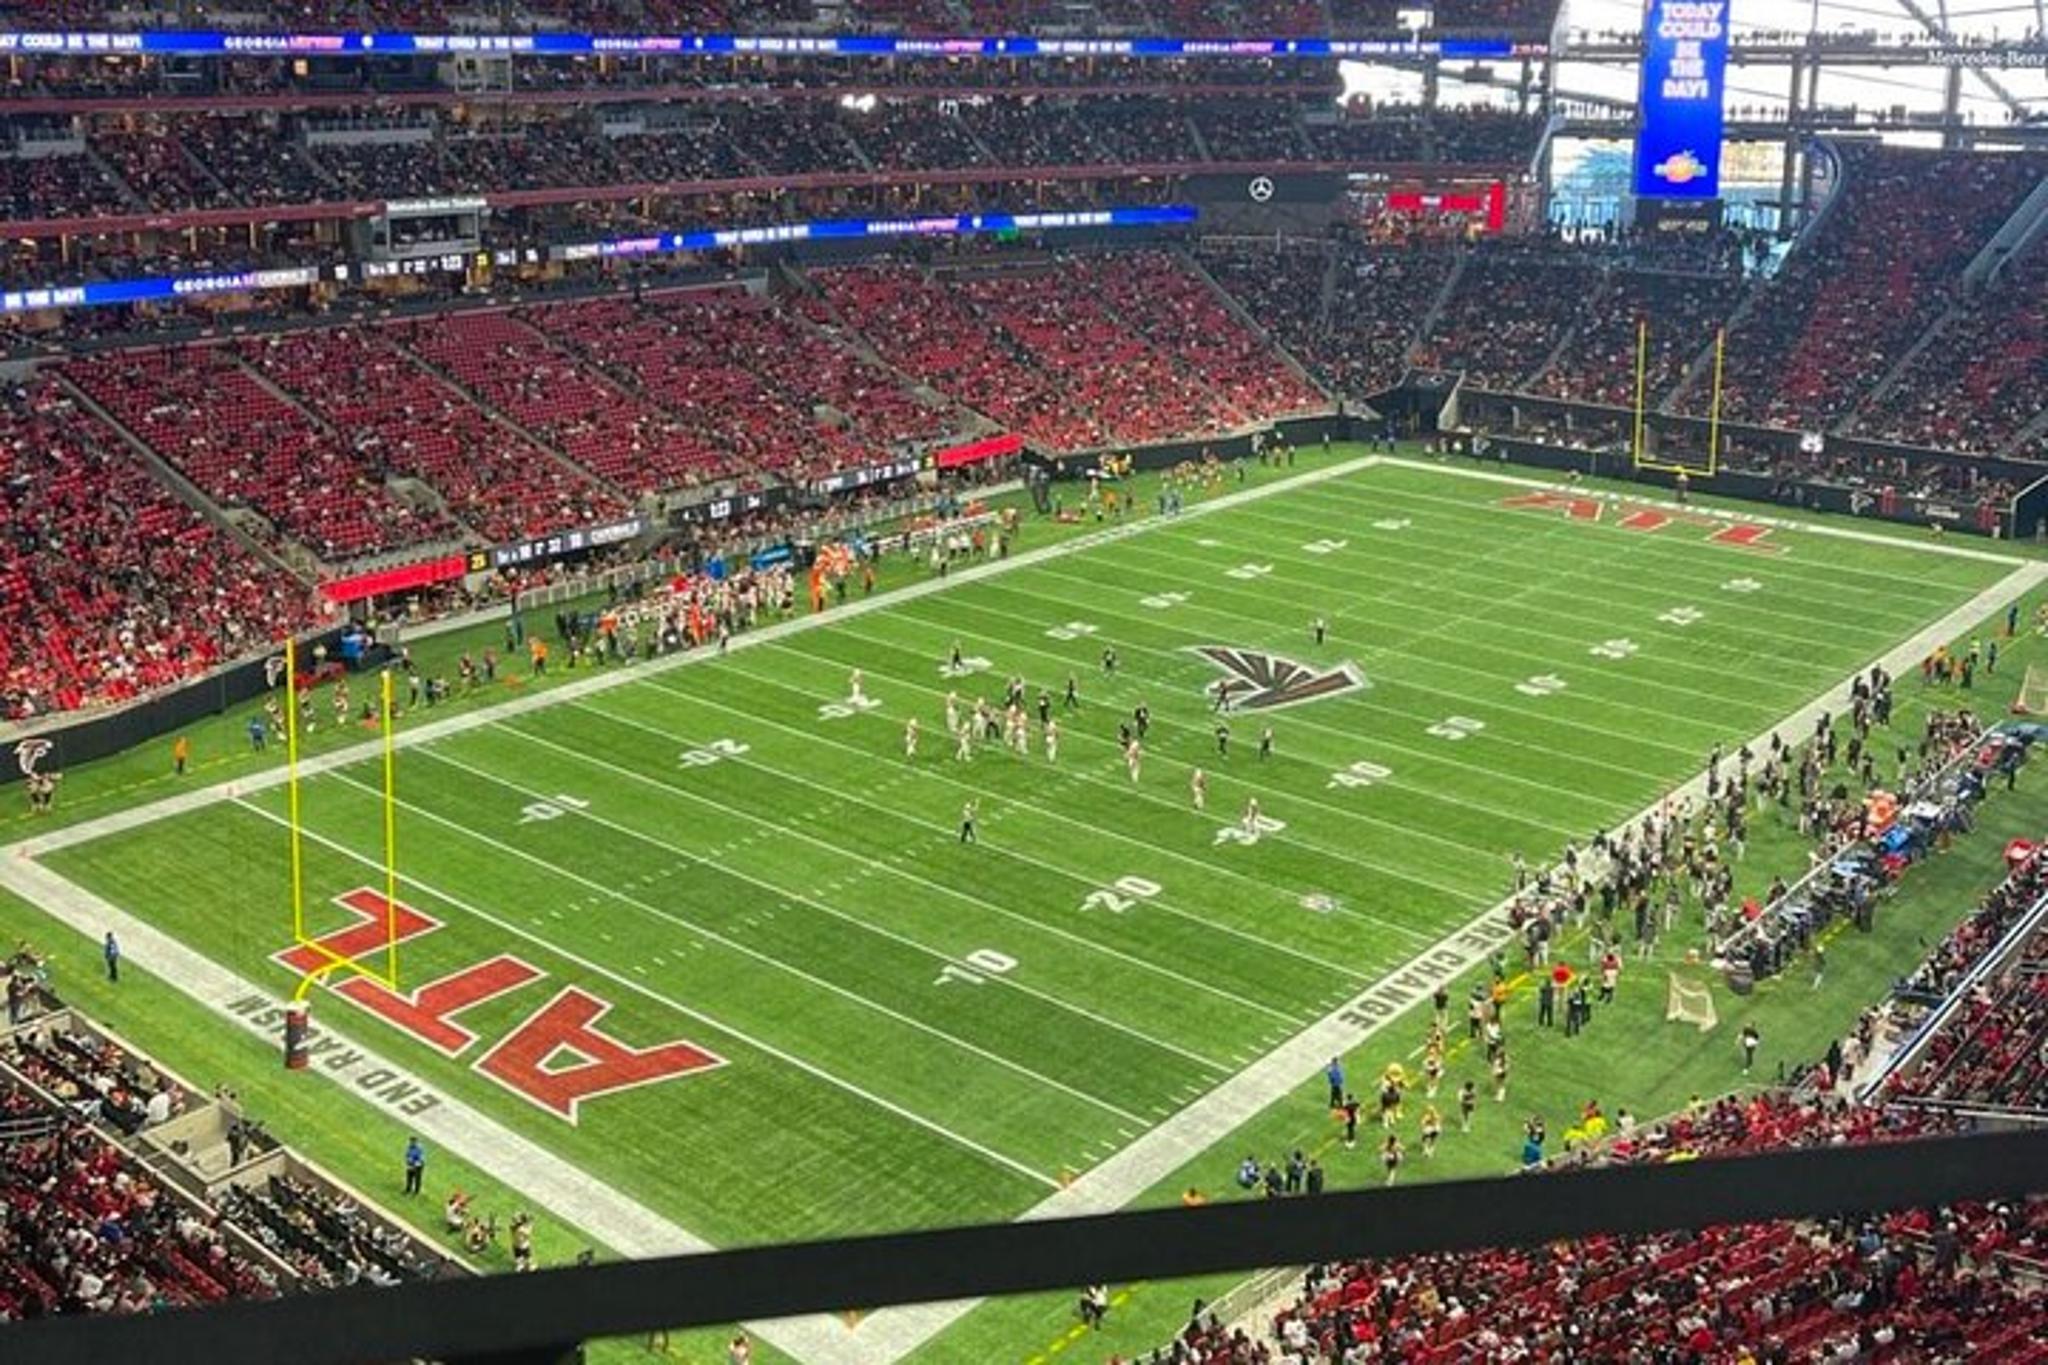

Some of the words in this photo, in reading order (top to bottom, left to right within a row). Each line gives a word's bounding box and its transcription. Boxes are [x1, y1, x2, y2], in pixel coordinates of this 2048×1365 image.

[1661, 2, 1723, 20] TODAY
[1658, 22, 1722, 38] COULD
[21, 34, 63, 47] COULD
[87, 34, 108, 47] THE
[223, 37, 288, 49] GEORGIA
[1675, 41, 1701, 58] BE
[1928, 50, 2046, 66] Mercedes-Benz
[1669, 59, 1705, 77] THE
[1662, 79, 1709, 97] DAY!
[172, 274, 246, 293] GEORGIA
[26, 288, 49, 306] THE
[1497, 488, 1791, 557] ATL
[1425, 716, 1486, 740] 50
[1326, 761, 1392, 788] 40
[1079, 875, 1162, 913] 20
[933, 949, 1019, 985] 10
[1338, 949, 1468, 1030] CHANGE
[268, 886, 731, 1127] ATL
[355, 1067, 452, 1117] END
